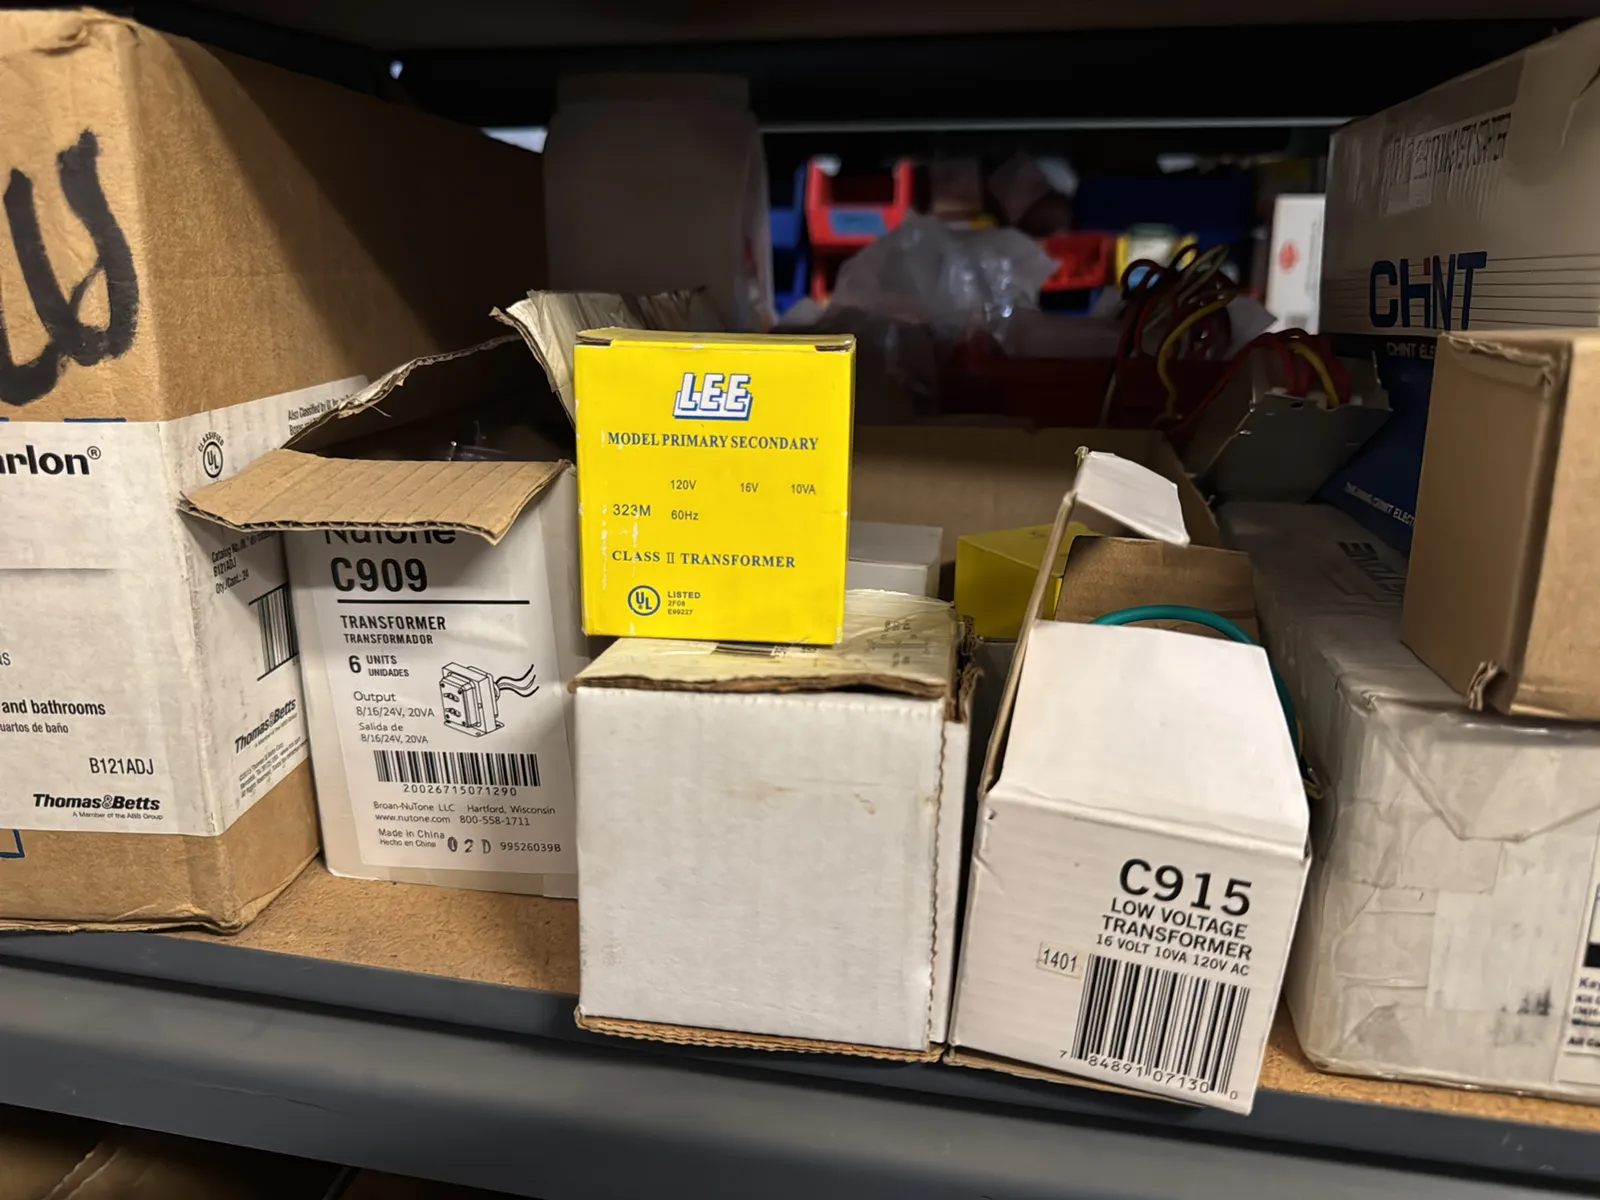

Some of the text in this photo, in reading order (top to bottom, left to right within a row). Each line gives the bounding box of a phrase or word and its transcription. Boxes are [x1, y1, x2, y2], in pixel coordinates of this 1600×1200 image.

[677, 372, 752, 413] LEE
[197, 432, 225, 453] CLASSIFIED
[608, 432, 819, 451] MODEL PRIMARY SECONDARY
[207, 451, 219, 470] UL
[670, 480, 817, 495] 120V 16V 10VA
[613, 504, 651, 517] 323M
[671, 509, 699, 521] 60Hz
[612, 550, 660, 562] CLASS
[681, 553, 796, 568] TRANSFORMER
[331, 557, 428, 592] C909
[667, 591, 701, 599] LISTED
[340, 615, 446, 630] TRANSFORMER
[344, 633, 434, 645] TRANSFORMADOR
[348, 655, 362, 674] 6
[366, 655, 397, 665] UNITS
[368, 668, 410, 678] UNIDADES
[353, 691, 397, 704] Output
[2, 699, 106, 715] and bathrooms
[356, 706, 436, 718] 8/16/24V, 20VA
[0, 721, 69, 734] uartos de baño
[358, 722, 404, 732] Salida de
[361, 734, 428, 745] 8/16/24V, 20VA
[89, 757, 155, 775] B121ADJ
[404, 784, 518, 797] 20026715071290
[33, 793, 160, 811] Thomas&Betts
[373, 801, 555, 815] Broan-NuTone LLC Hartford, Wisconsin
[375, 814, 530, 826] www.nutone.com 800-558-1711
[378, 828, 445, 839] Made in China
[380, 838, 402, 847] Hecho
[417, 839, 436, 848] China
[464, 839, 473, 854] 2
[1119, 858, 1253, 917] C915
[1111, 898, 1248, 940] LOW VOLTAGE
[1102, 915, 1252, 961] TRANSFORMER
[1043, 949, 1078, 973] 1401
[1097, 933, 1250, 976] 16 VOLT 10VA 120V AC
[1088, 1055, 1143, 1078] 84891
[1153, 1070, 1209, 1093] 07130
[1230, 1090, 1238, 1100] 0
